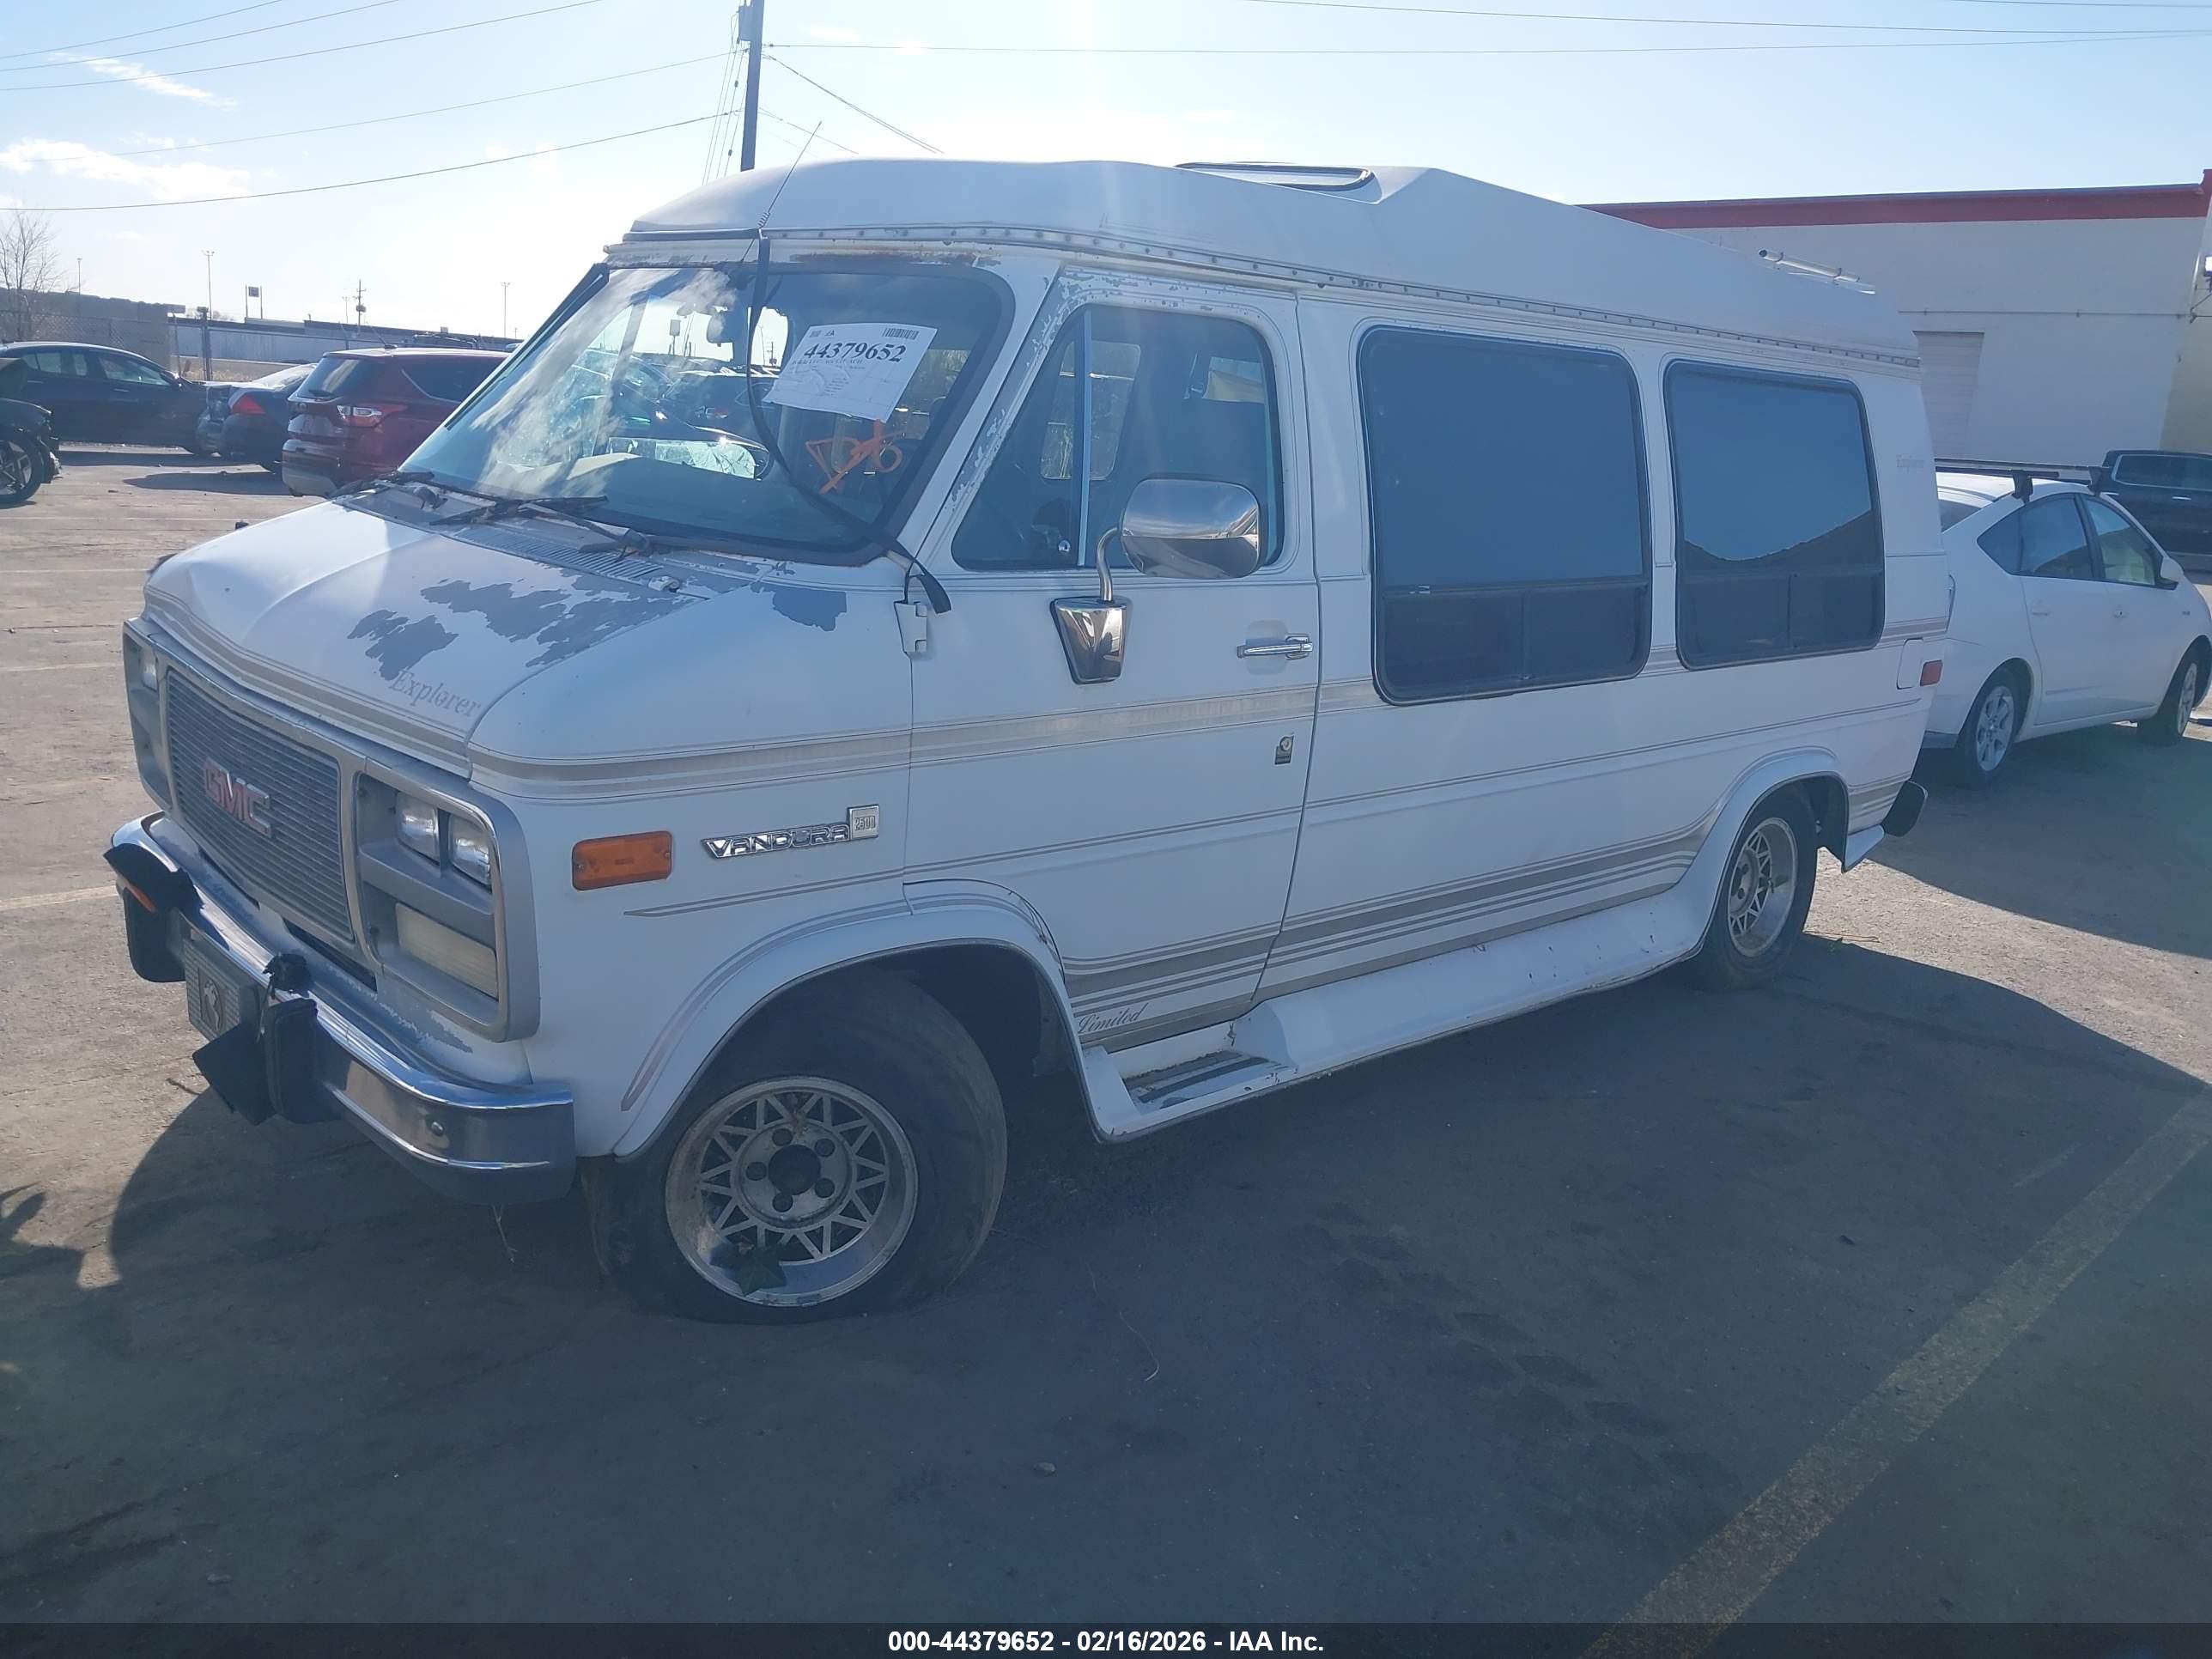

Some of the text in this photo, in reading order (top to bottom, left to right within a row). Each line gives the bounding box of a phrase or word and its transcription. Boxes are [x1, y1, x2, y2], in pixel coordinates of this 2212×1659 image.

[803, 340, 908, 363] 44379652
[388, 666, 482, 718] Explorer
[204, 756, 273, 839] GMC
[703, 815, 876, 858] VANDURA 2500
[1078, 1001, 1150, 1034] Limited
